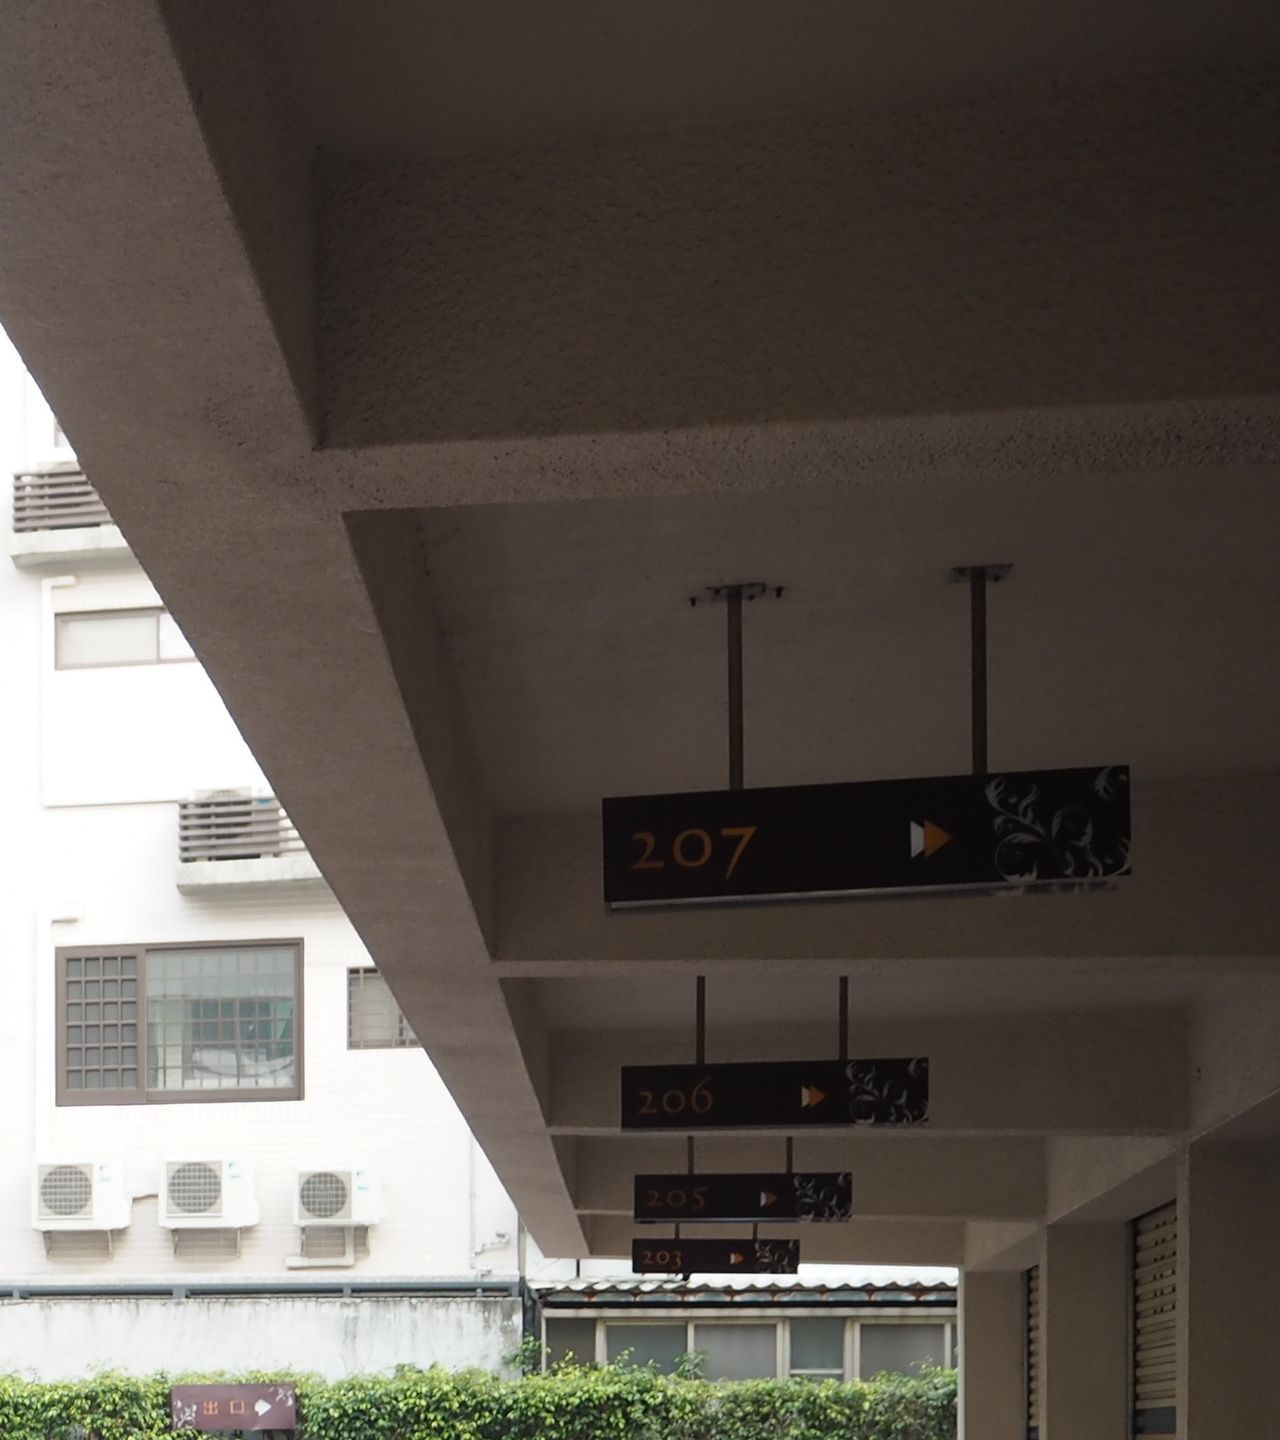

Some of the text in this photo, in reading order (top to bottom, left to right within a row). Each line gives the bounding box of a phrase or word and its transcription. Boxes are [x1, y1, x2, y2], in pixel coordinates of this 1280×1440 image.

[630, 825, 757, 880] 207
[638, 1076, 714, 1115] 206
[647, 1186, 708, 1210] 205
[643, 1250, 683, 1269] 203
[203, 1400, 245, 1415] 出口
